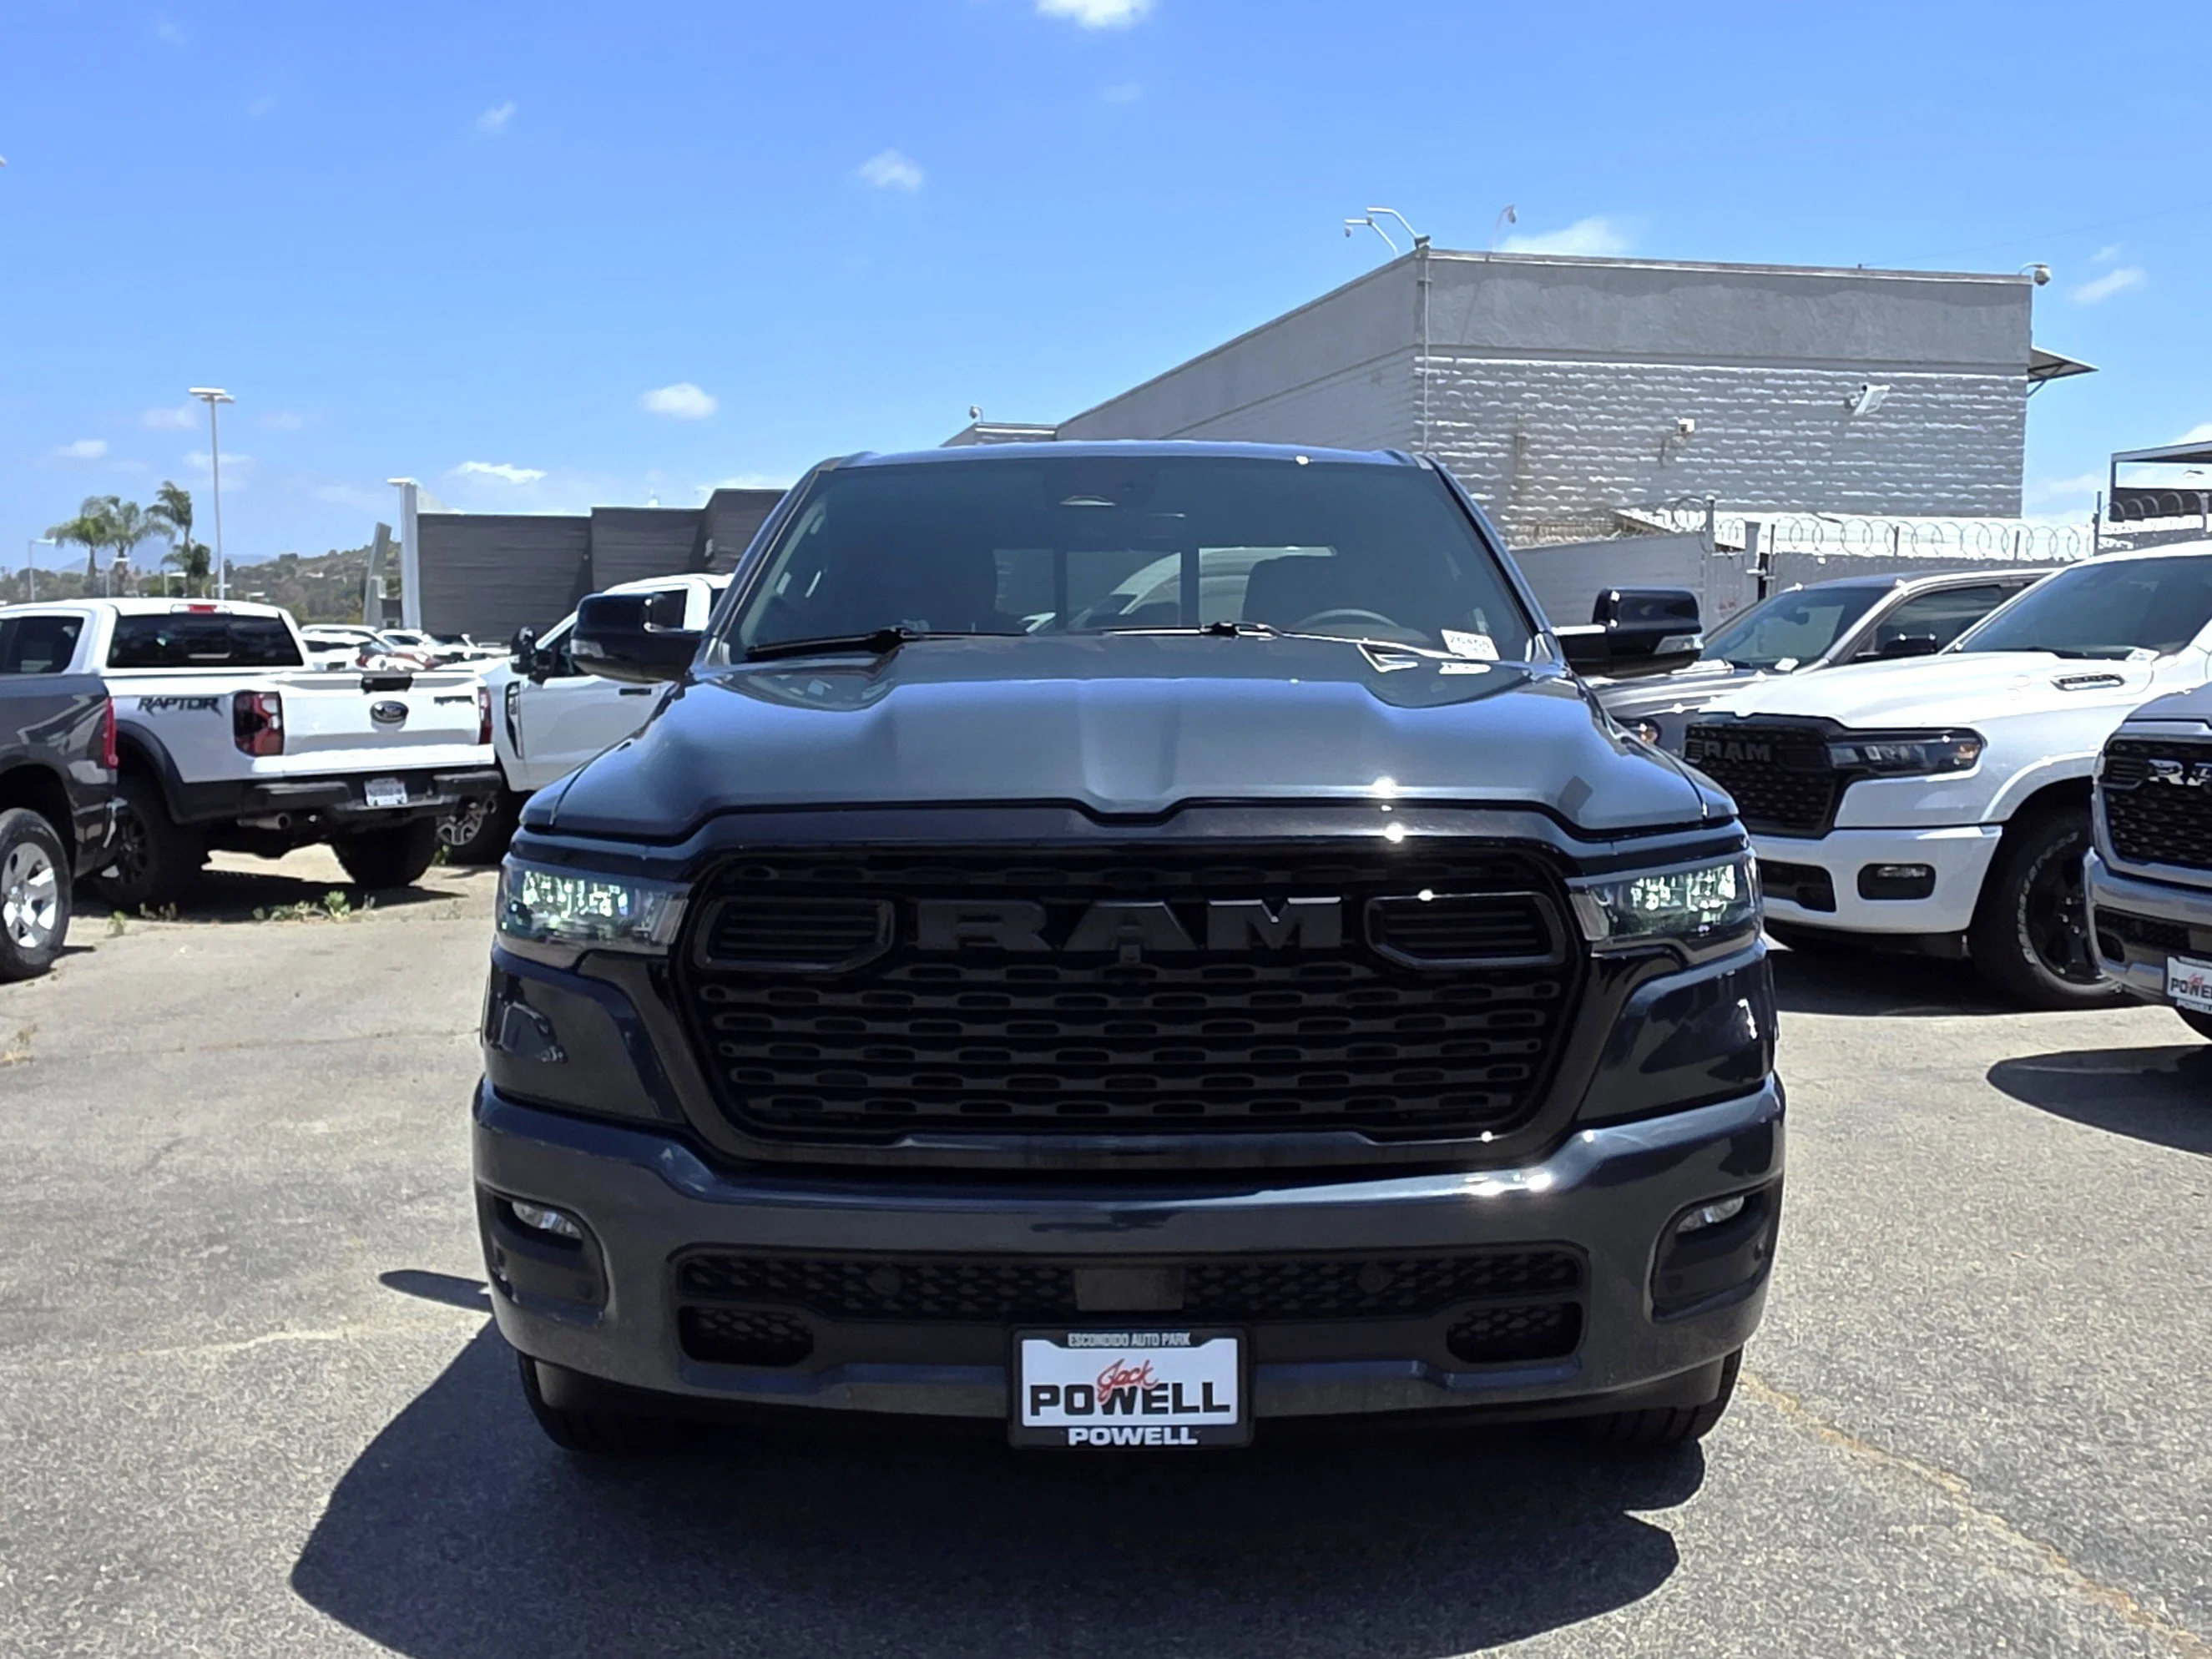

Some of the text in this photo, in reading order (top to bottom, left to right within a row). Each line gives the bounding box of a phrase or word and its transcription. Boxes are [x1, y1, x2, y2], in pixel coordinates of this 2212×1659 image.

[137, 698, 224, 717] RAPTOR
[1704, 740, 1770, 763] RAM
[918, 897, 1342, 964] RAM
[2170, 977, 2212, 999] POWE
[1068, 1332, 1190, 1347] ESCONDIDO AUTO PARK
[1096, 1358, 1159, 1402] Jack
[1030, 1382, 1230, 1416] POWELL
[1068, 1427, 1198, 1445] POWELL
